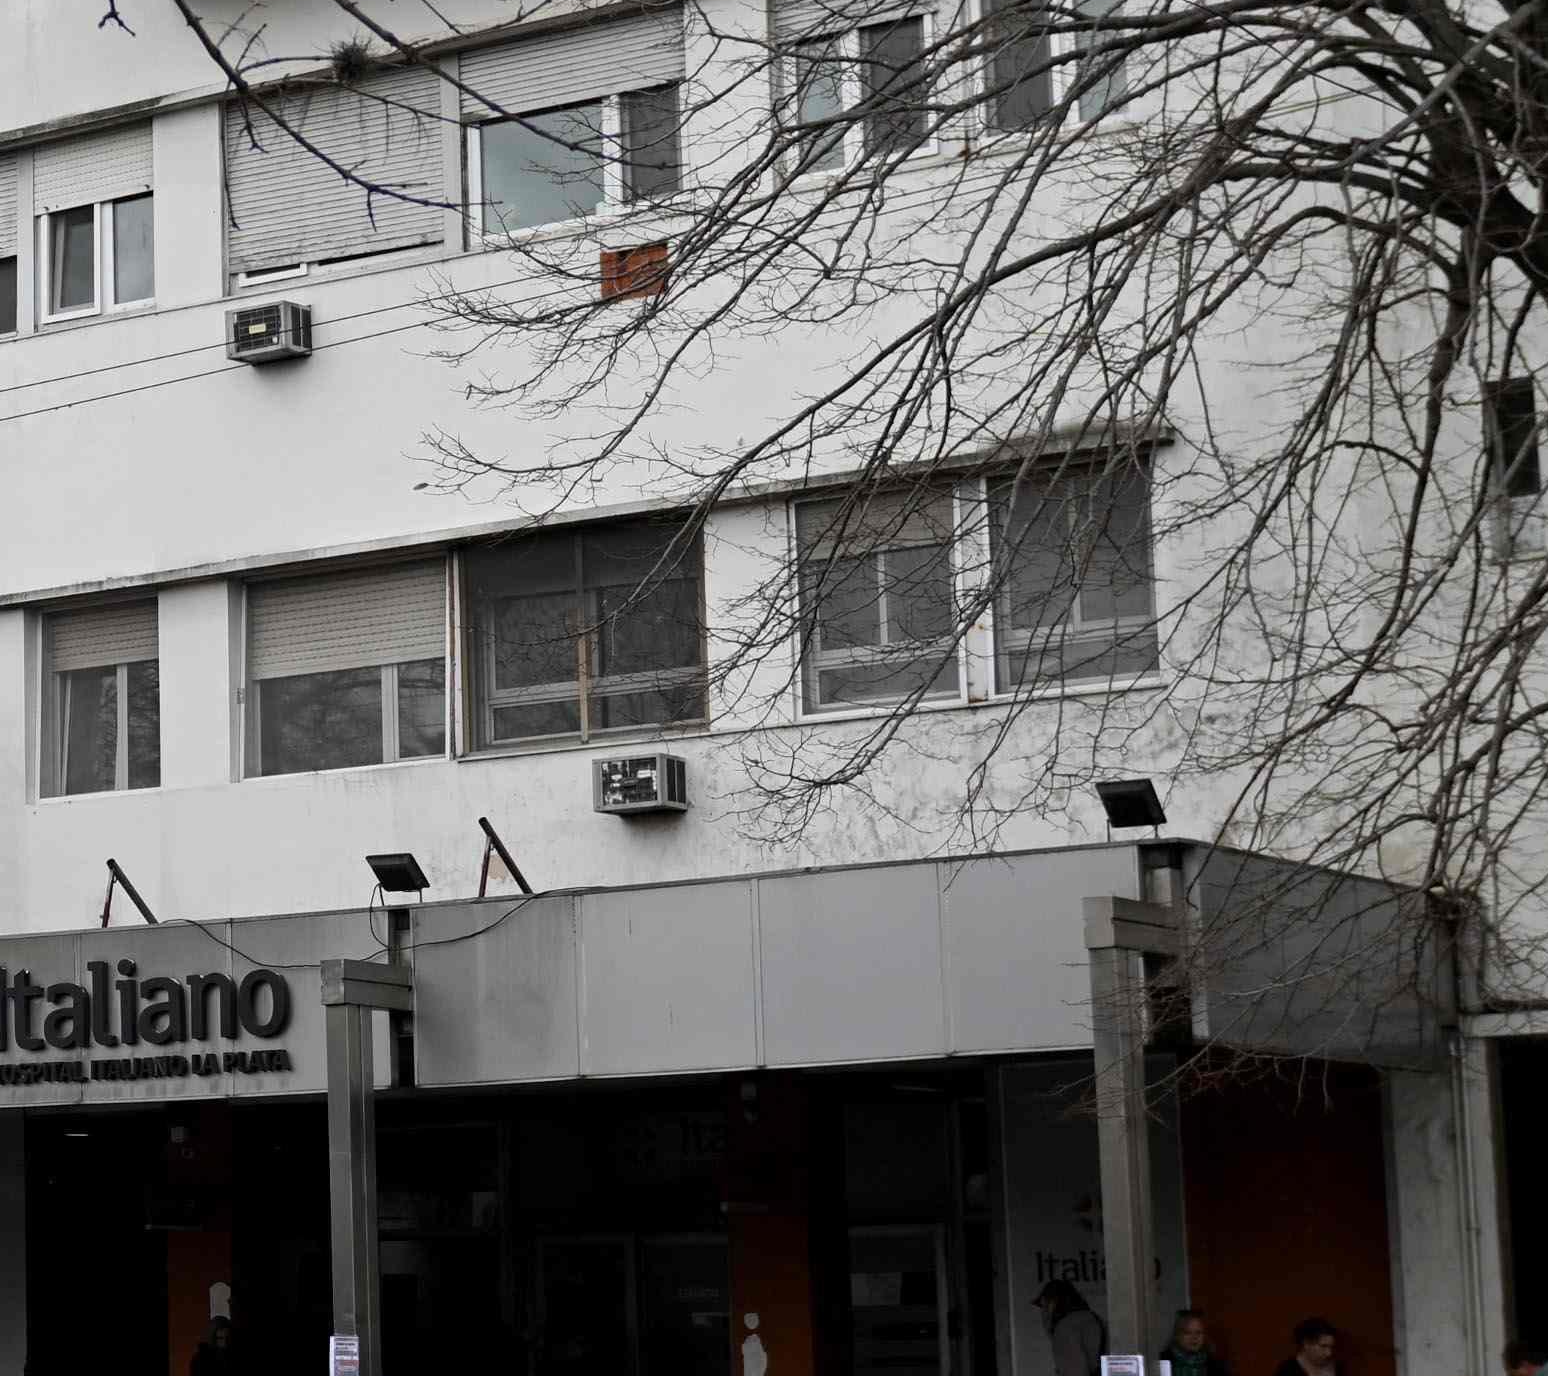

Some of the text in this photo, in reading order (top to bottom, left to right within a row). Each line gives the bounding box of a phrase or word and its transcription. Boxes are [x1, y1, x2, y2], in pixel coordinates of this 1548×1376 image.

[90, 1055, 189, 1080] ITALIANO
[191, 1053, 220, 1075] LA
[223, 1050, 291, 1073] PLATA
